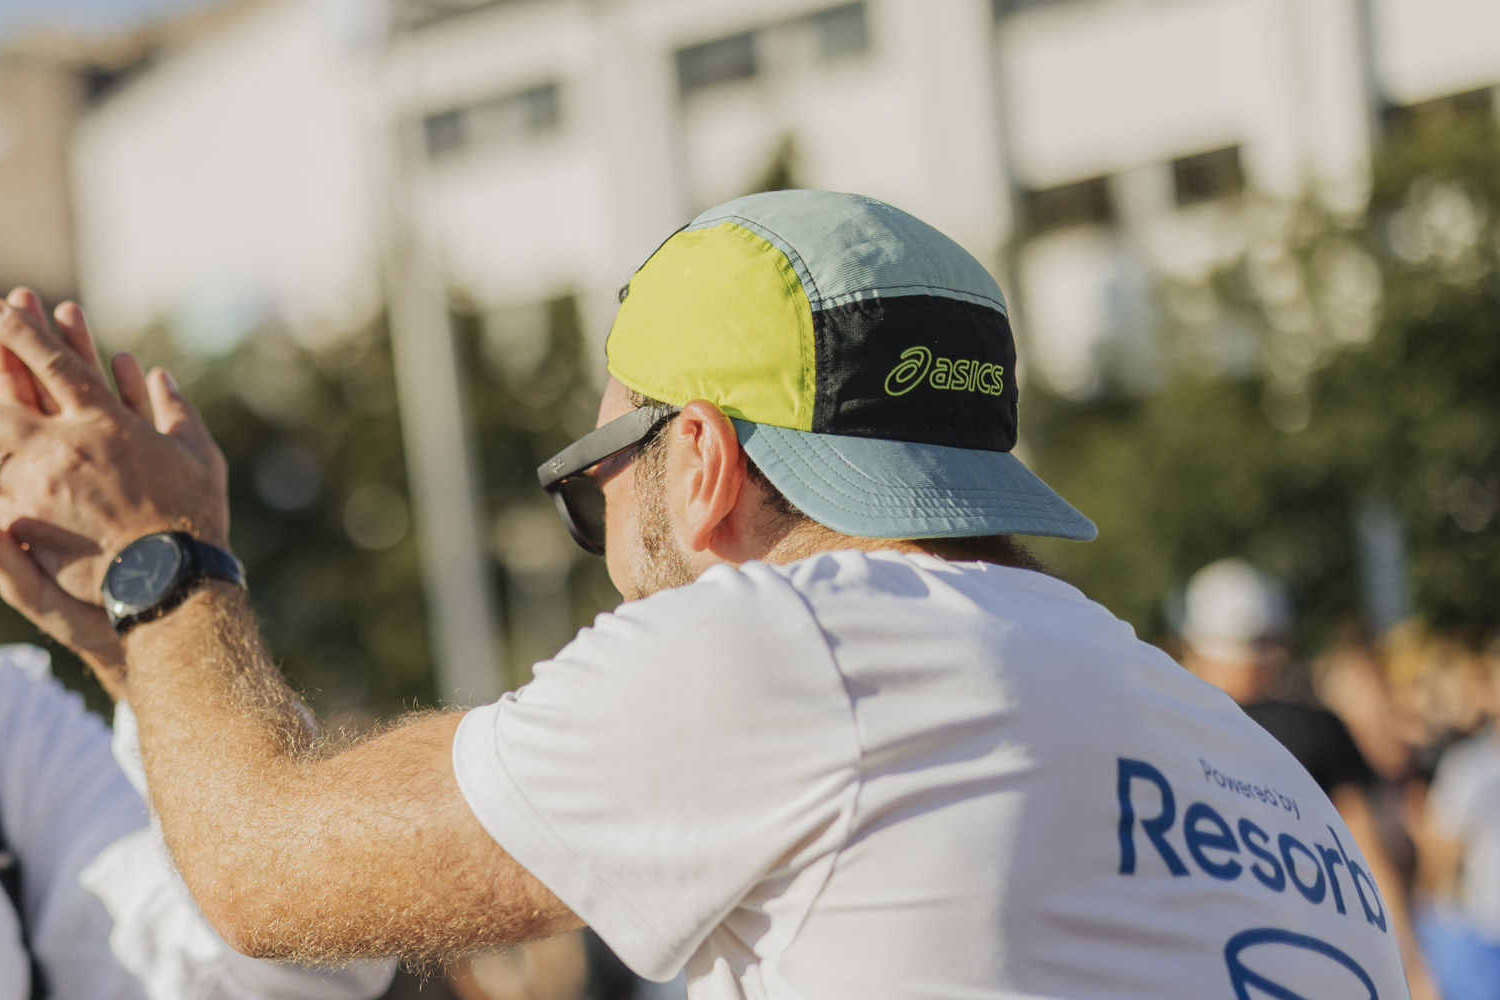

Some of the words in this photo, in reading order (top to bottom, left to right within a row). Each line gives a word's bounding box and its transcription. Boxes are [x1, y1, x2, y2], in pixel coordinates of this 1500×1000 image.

[1116, 756, 1387, 933] Resorb
[1199, 758, 1278, 807] Powered
[1272, 787, 1300, 820] by
